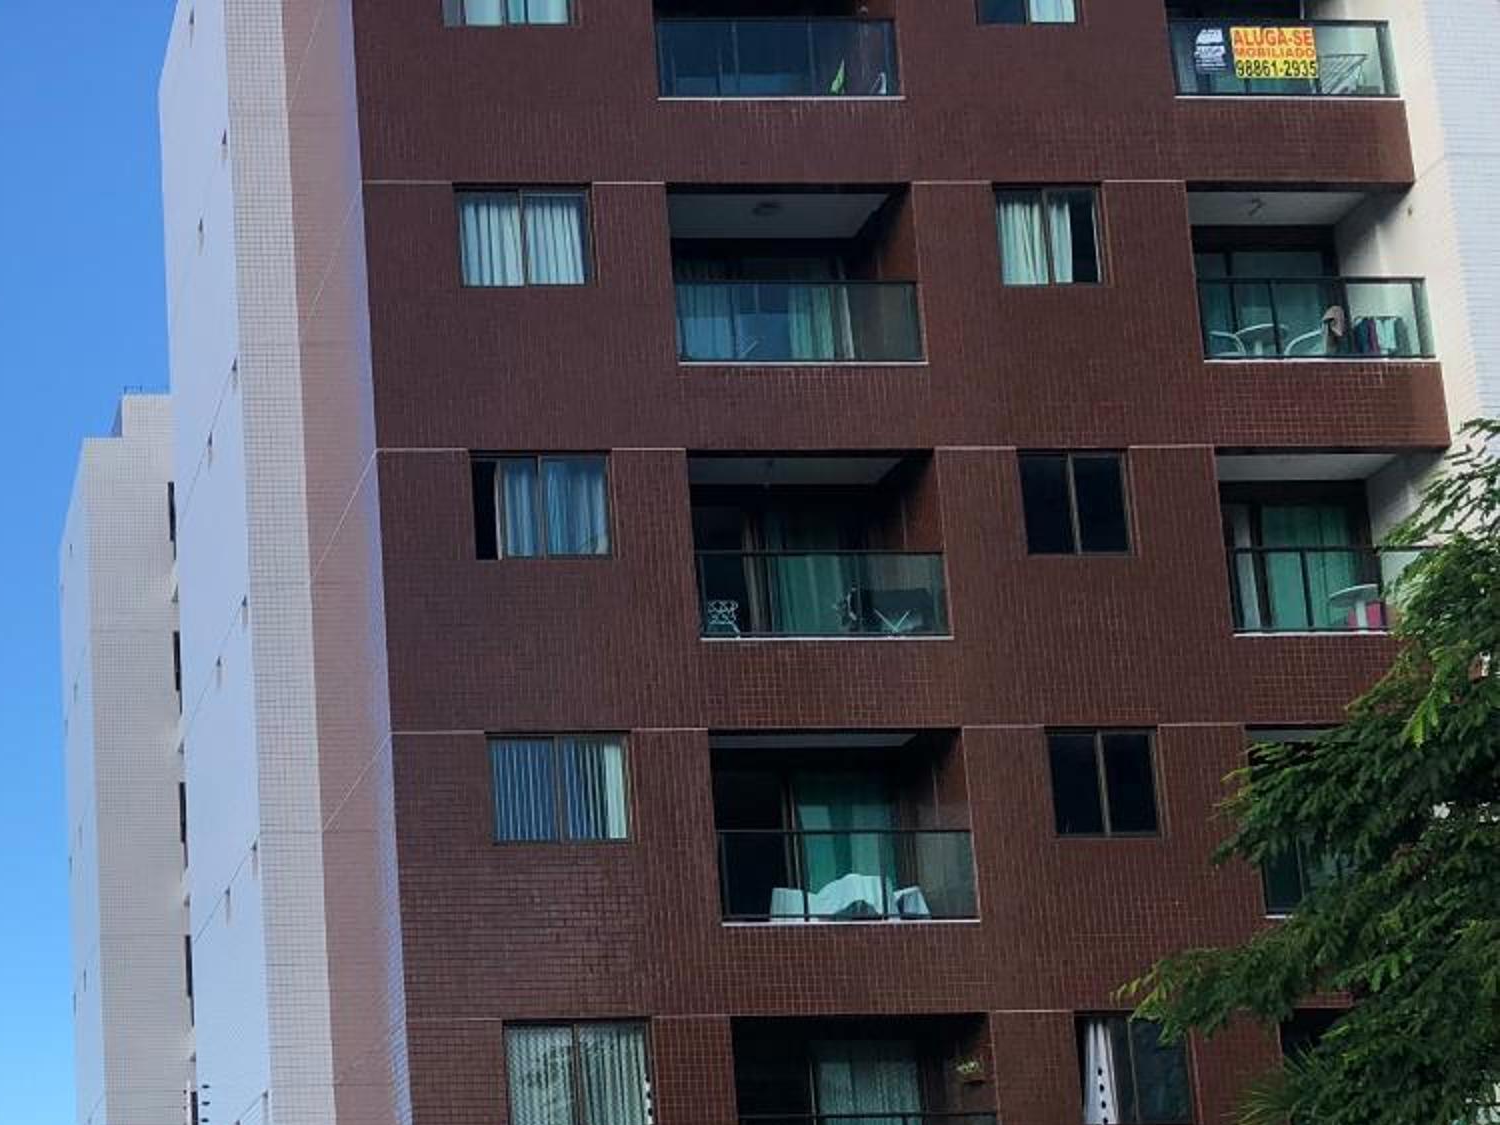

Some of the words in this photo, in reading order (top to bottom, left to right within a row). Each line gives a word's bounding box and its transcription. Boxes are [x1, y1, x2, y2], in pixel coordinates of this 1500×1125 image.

[1233, 29, 1313, 46] ALUGA-SE
[1234, 47, 1315, 58] MOBILIADO
[1235, 60, 1317, 76] 98861-2935
